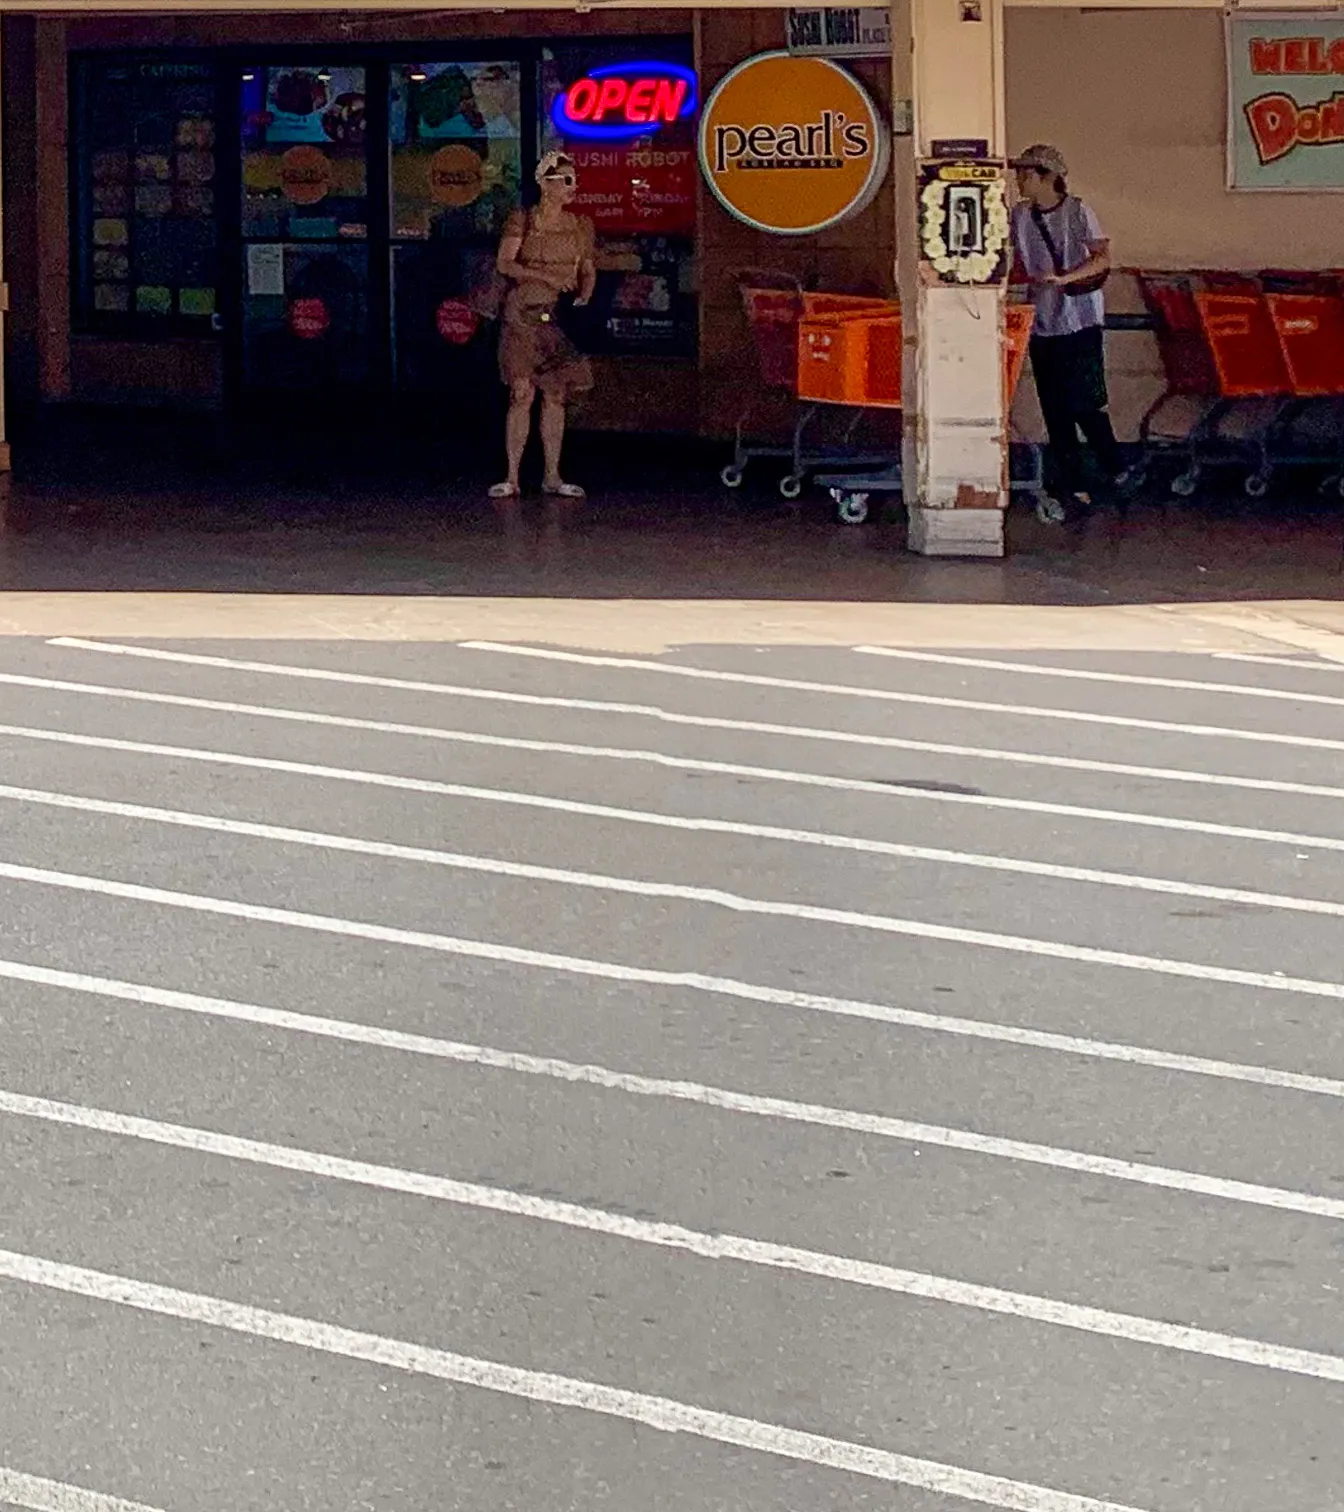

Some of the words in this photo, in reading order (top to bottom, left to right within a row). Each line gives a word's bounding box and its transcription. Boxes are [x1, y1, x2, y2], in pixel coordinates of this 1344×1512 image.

[564, 78, 687, 122] OPEN
[625, 151, 691, 168] ROBOT
[714, 109, 868, 173] pearl's
